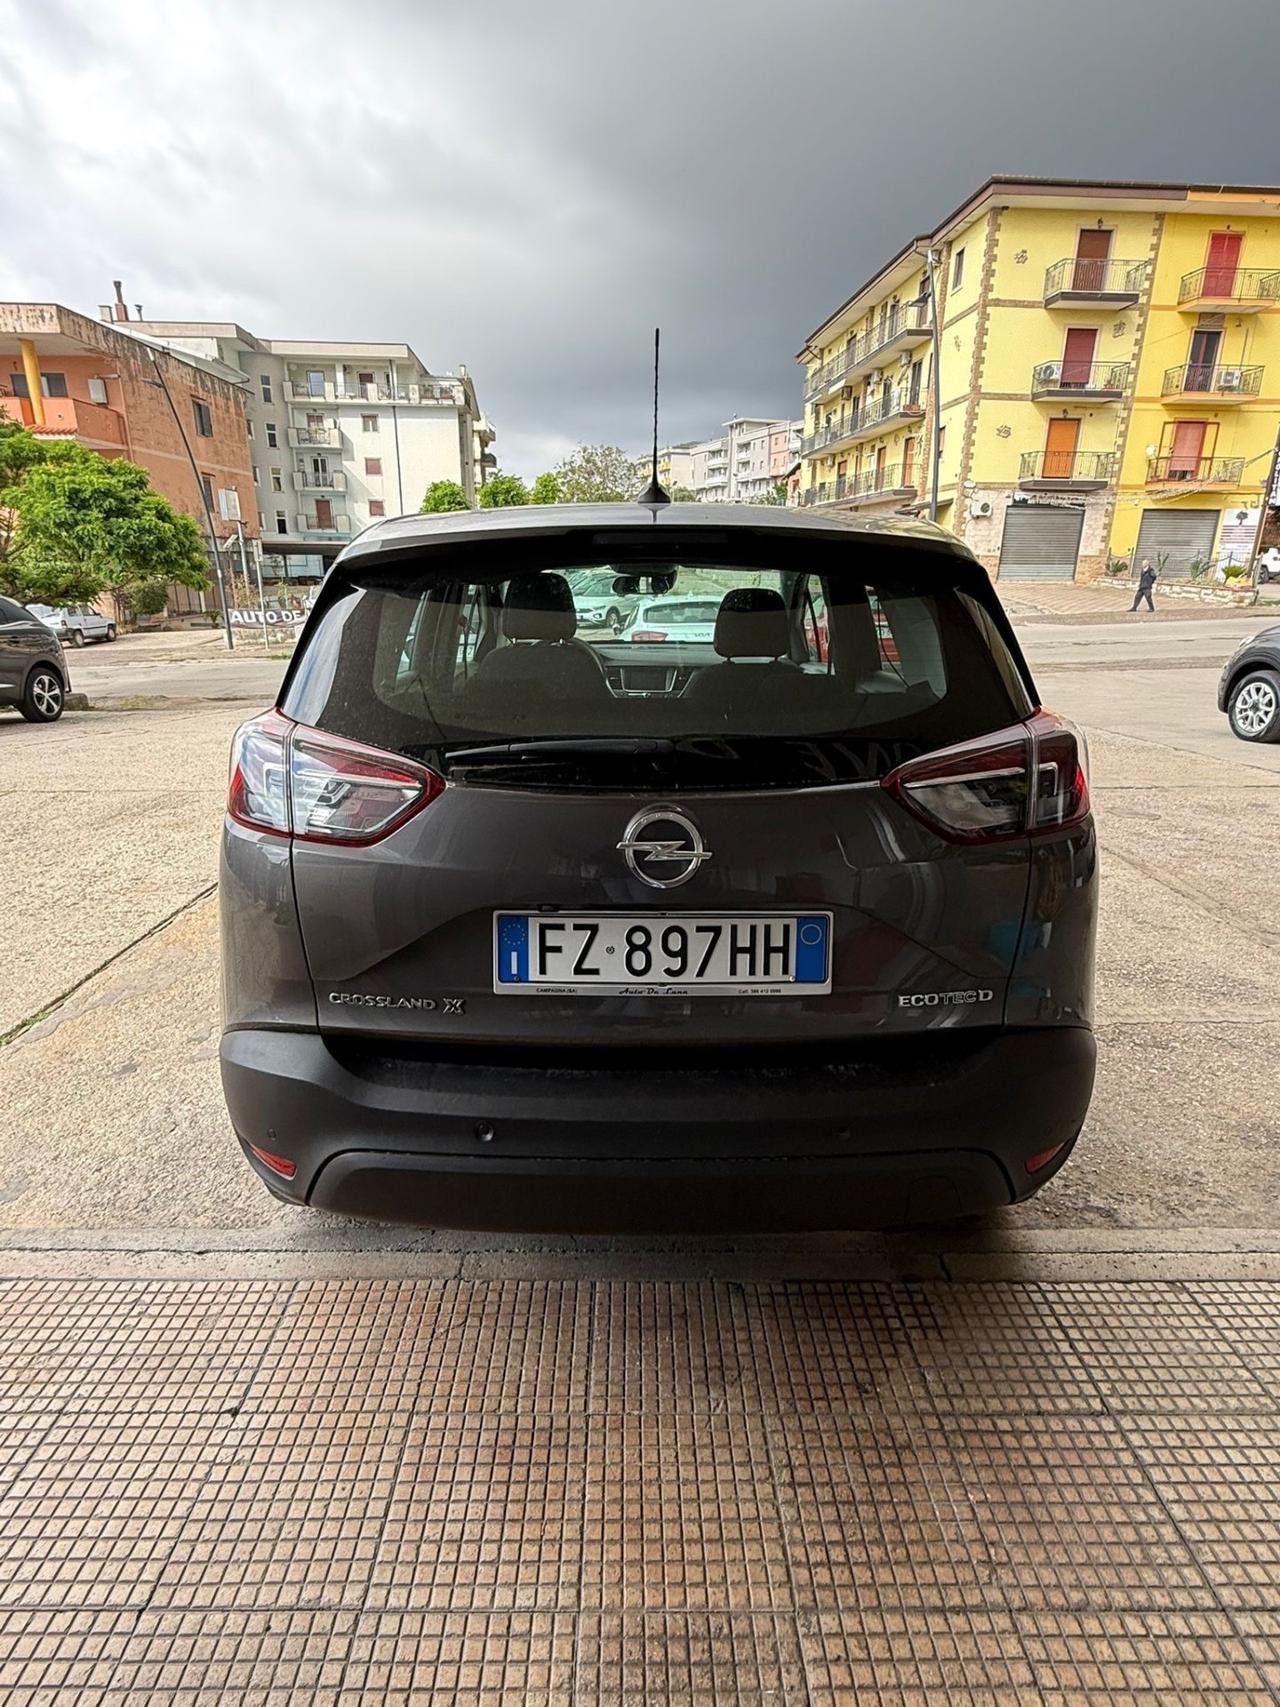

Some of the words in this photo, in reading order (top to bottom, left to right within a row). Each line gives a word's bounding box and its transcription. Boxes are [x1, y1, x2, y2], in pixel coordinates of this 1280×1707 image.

[231, 610, 278, 623] AUTO
[281, 610, 301, 622] DE
[538, 923, 600, 976] FZ
[624, 923, 790, 977] 897HH
[618, 987, 643, 995] Auto
[328, 992, 438, 1010] CROSSLAND
[442, 998, 465, 1014] X
